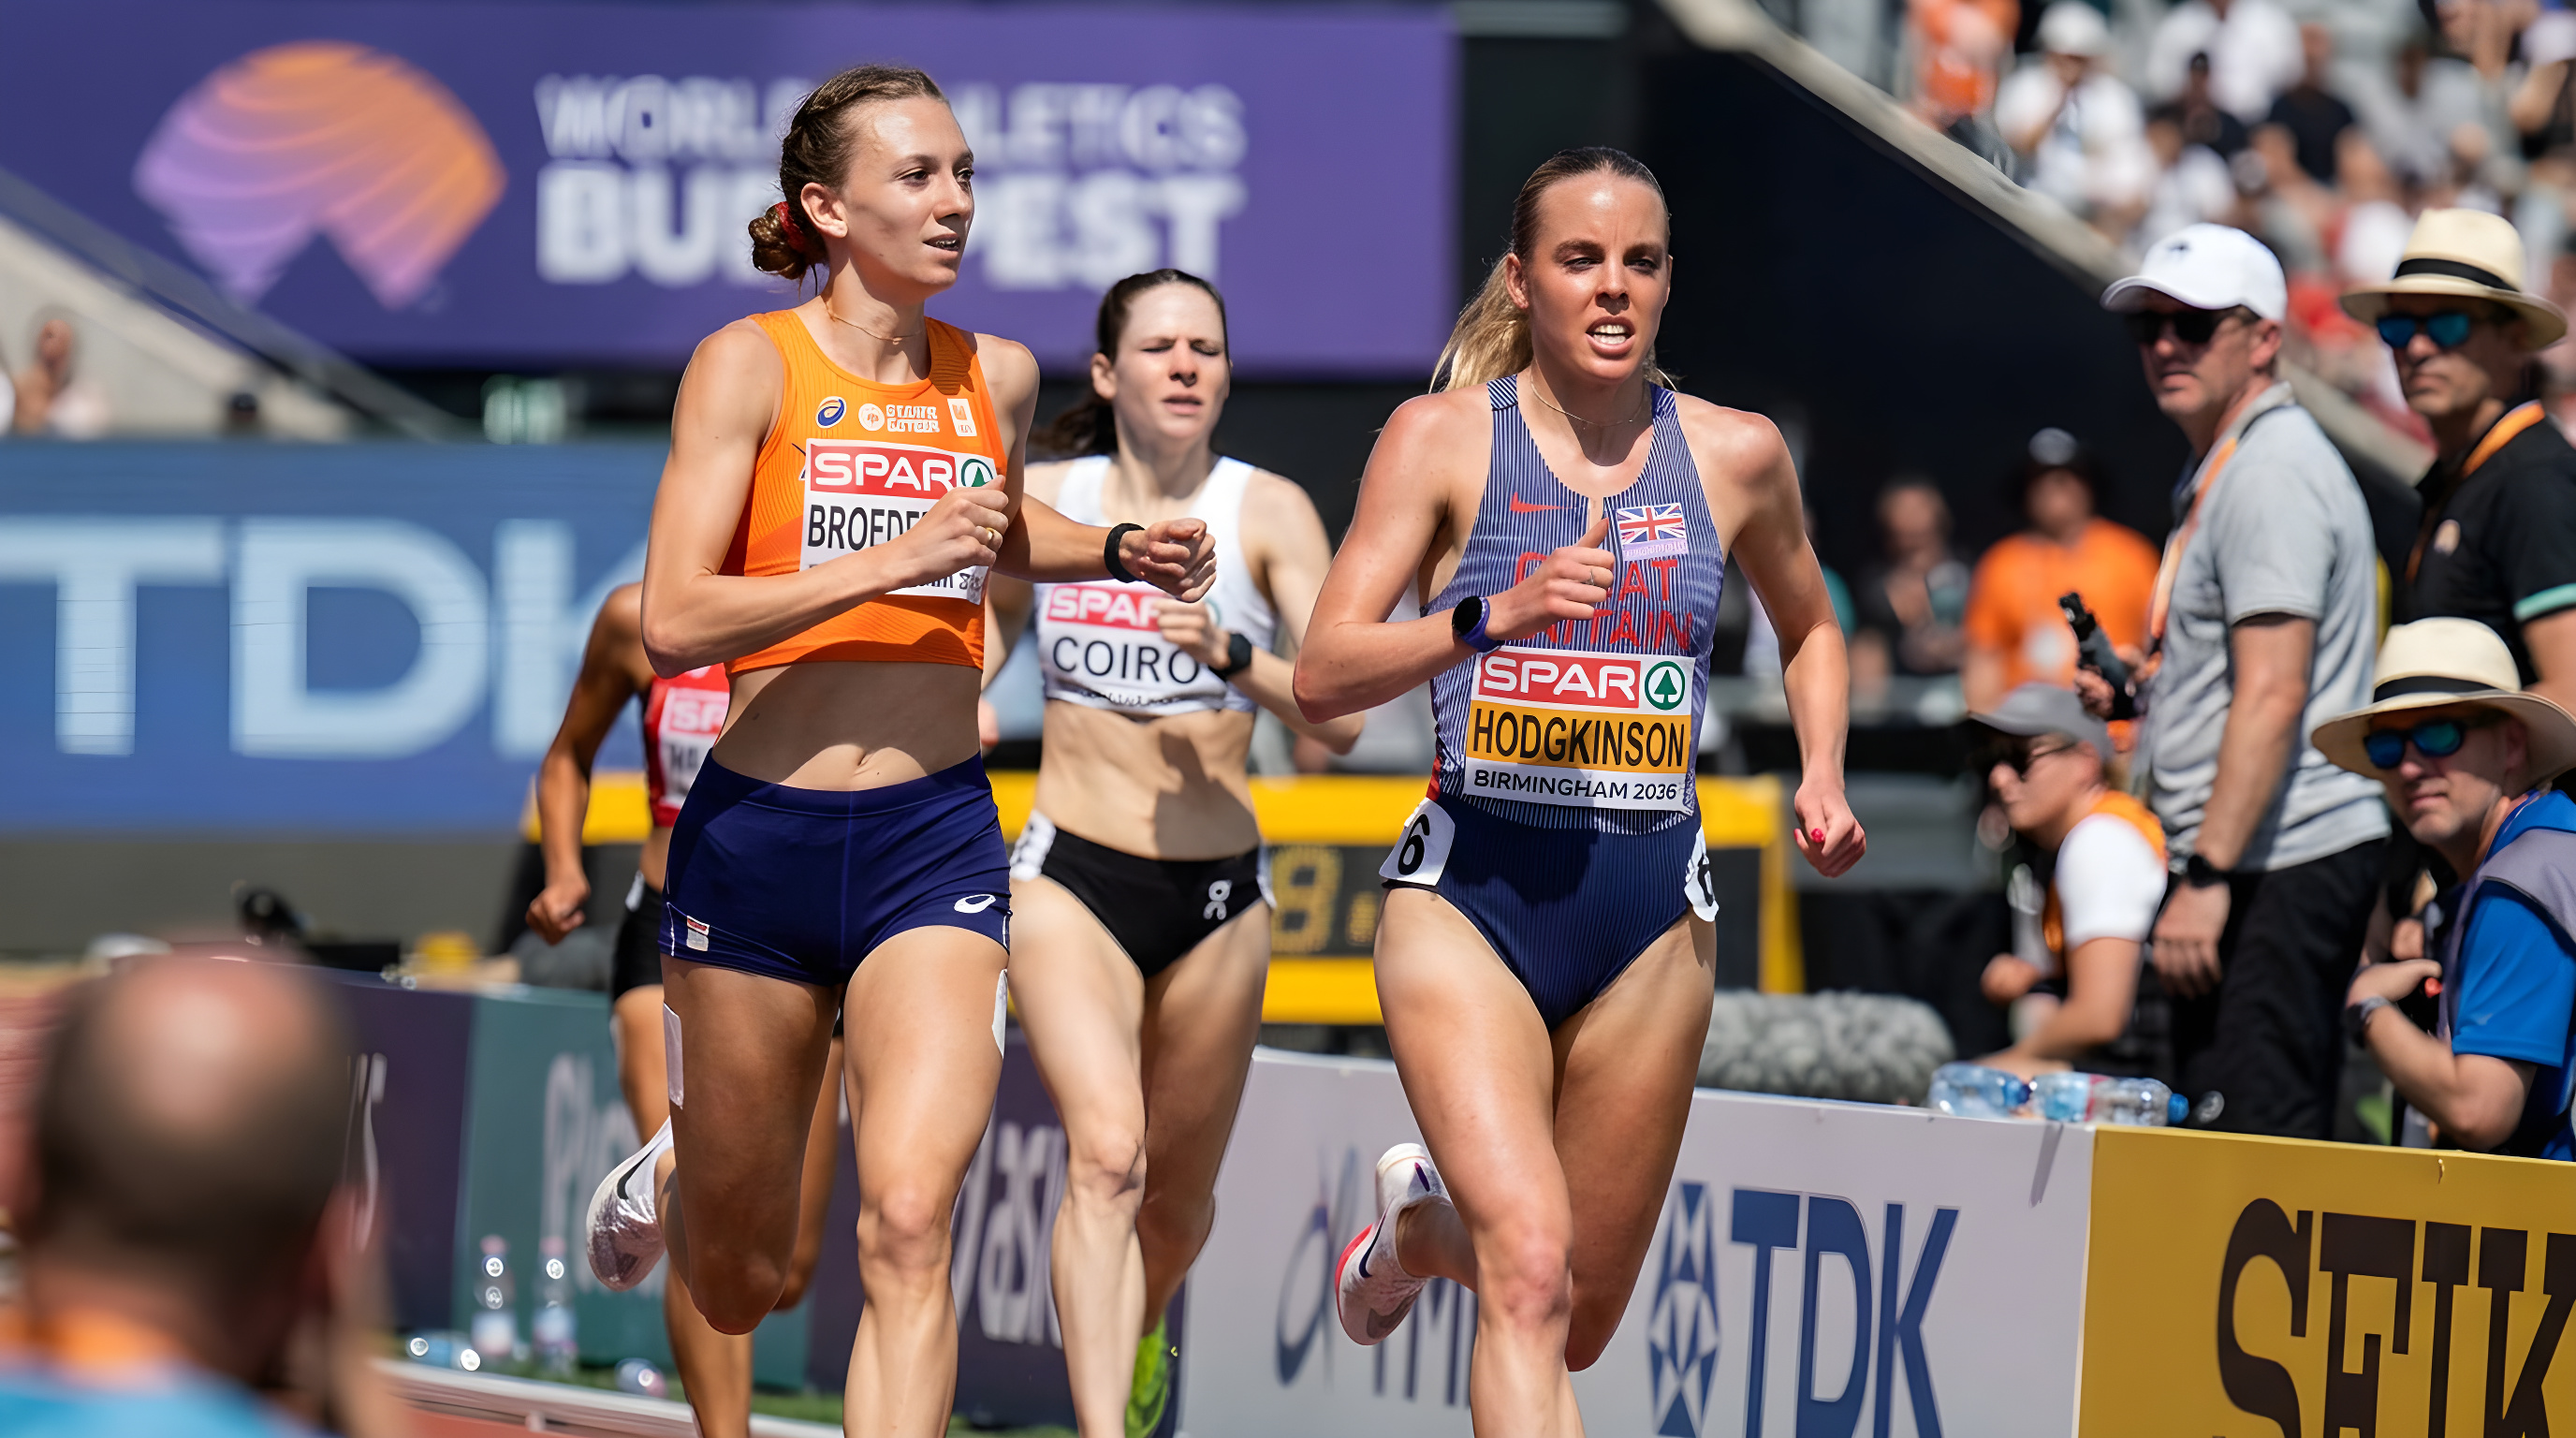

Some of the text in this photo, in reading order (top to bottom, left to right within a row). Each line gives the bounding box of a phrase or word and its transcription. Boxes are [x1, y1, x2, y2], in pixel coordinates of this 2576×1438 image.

[814, 452, 955, 492] SPAR
[808, 504, 929, 551] BROED
[1053, 637, 1199, 683] COIRO
[1484, 656, 1635, 700] SPAR
[1473, 709, 1684, 768] HODGKINSON
[1473, 770, 1677, 800] BIRMINGHAM 2036
[1398, 814, 1430, 875] 6
[1730, 1188, 1960, 1438] TDK
